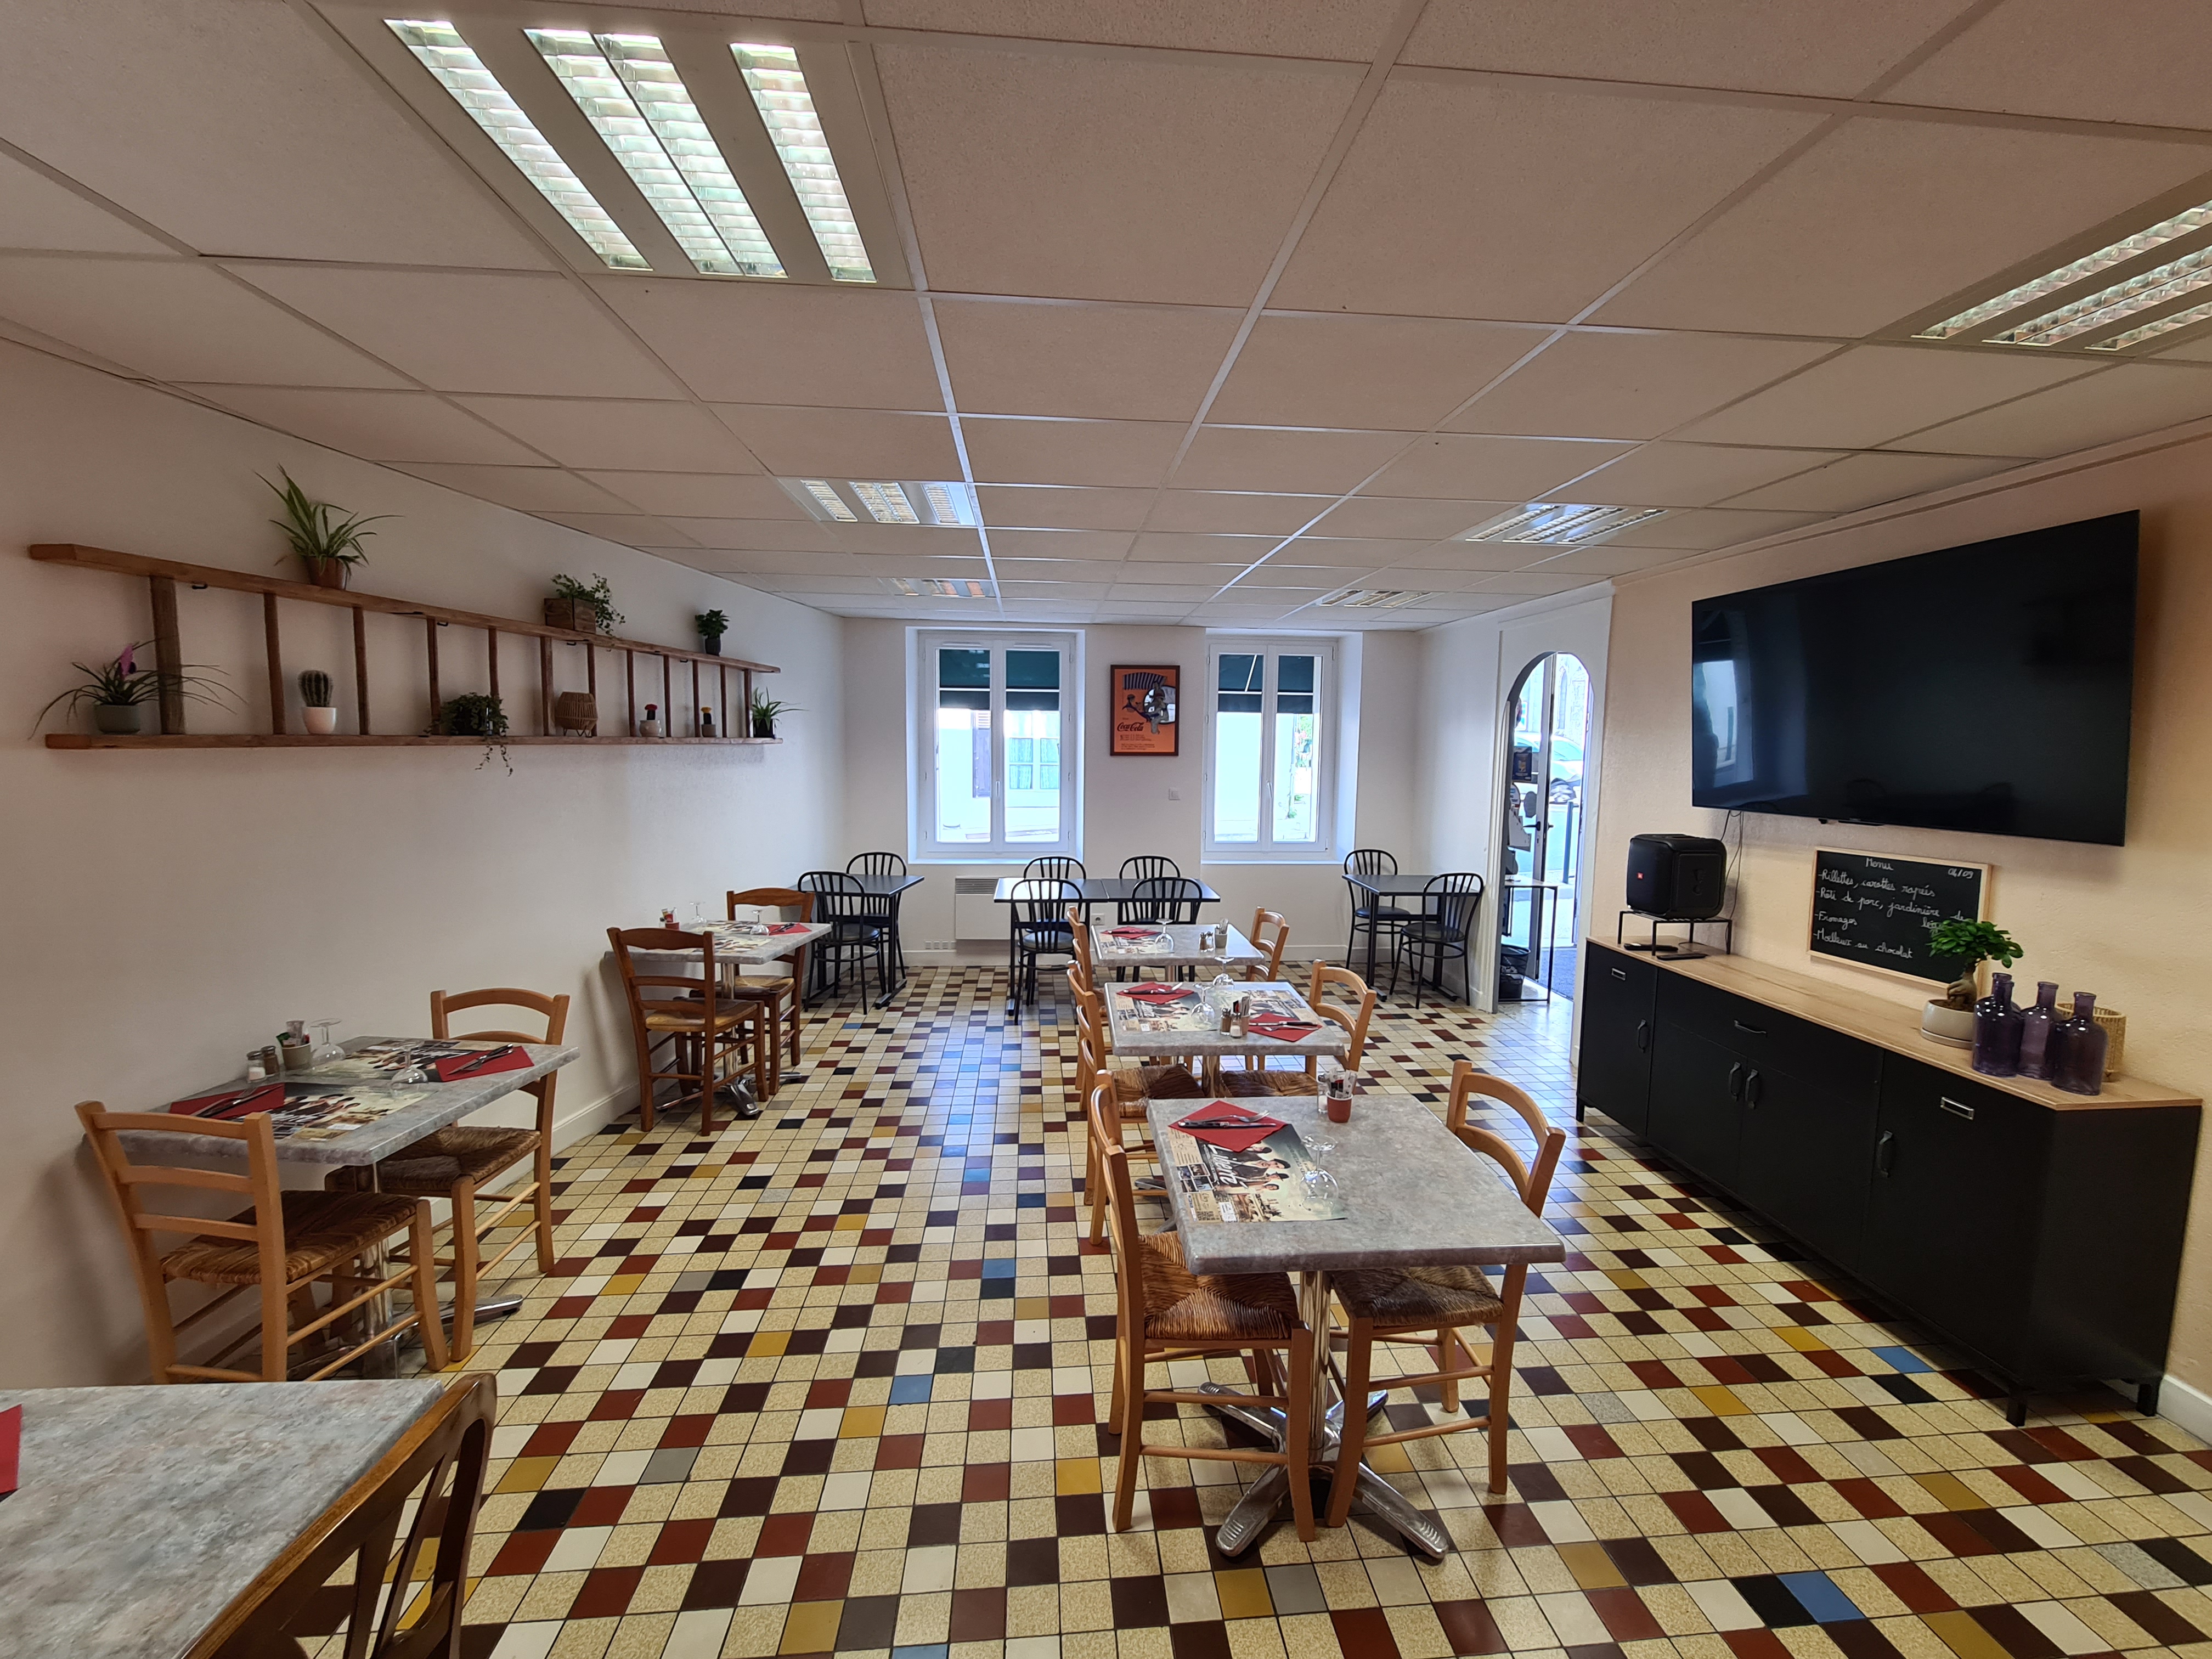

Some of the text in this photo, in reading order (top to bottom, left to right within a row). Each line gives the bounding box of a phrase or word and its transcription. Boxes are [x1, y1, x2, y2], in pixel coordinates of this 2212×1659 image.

[1866, 857, 1894, 871] Menu
[1860, 877, 1895, 890] carottes
[1842, 890, 1854, 902] de
[1875, 941, 1913, 958] chocolat
[1207, 1143, 1249, 1189] Liberté
